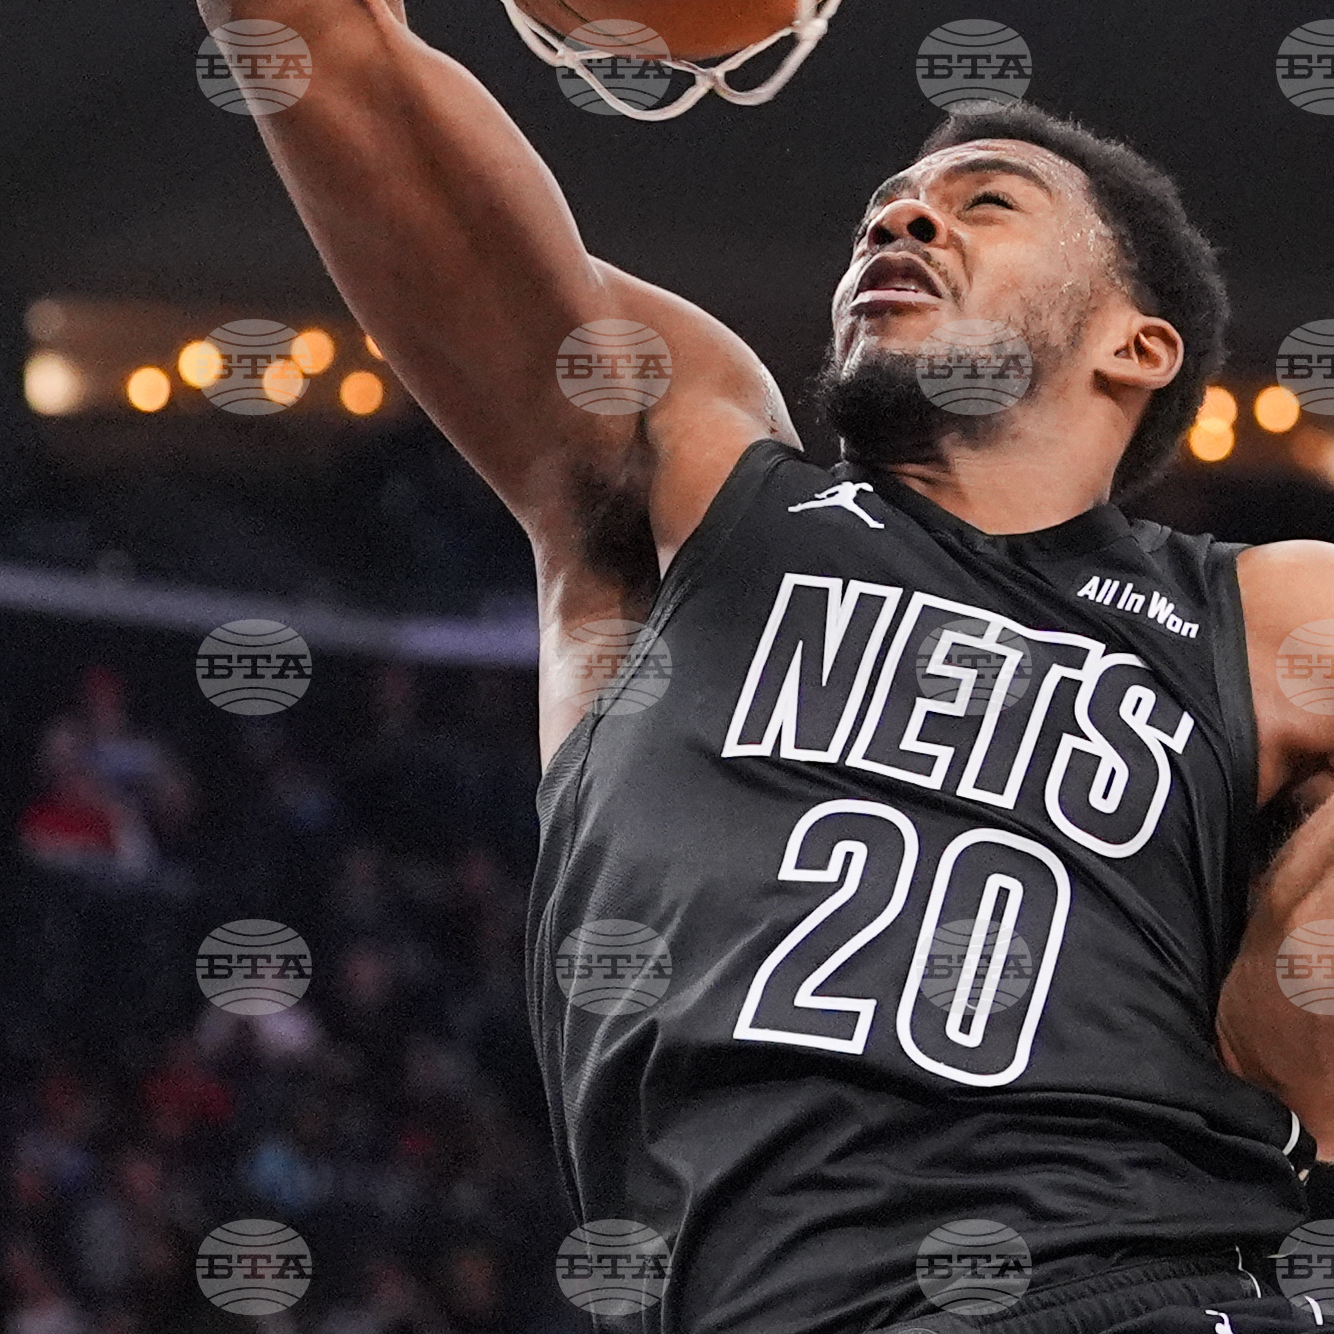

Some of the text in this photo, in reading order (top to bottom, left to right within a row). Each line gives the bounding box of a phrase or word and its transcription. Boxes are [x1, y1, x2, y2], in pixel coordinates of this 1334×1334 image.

[723, 573, 1195, 860] NETS
[1076, 575, 1200, 639] All In Won
[734, 800, 1071, 1087] 20
